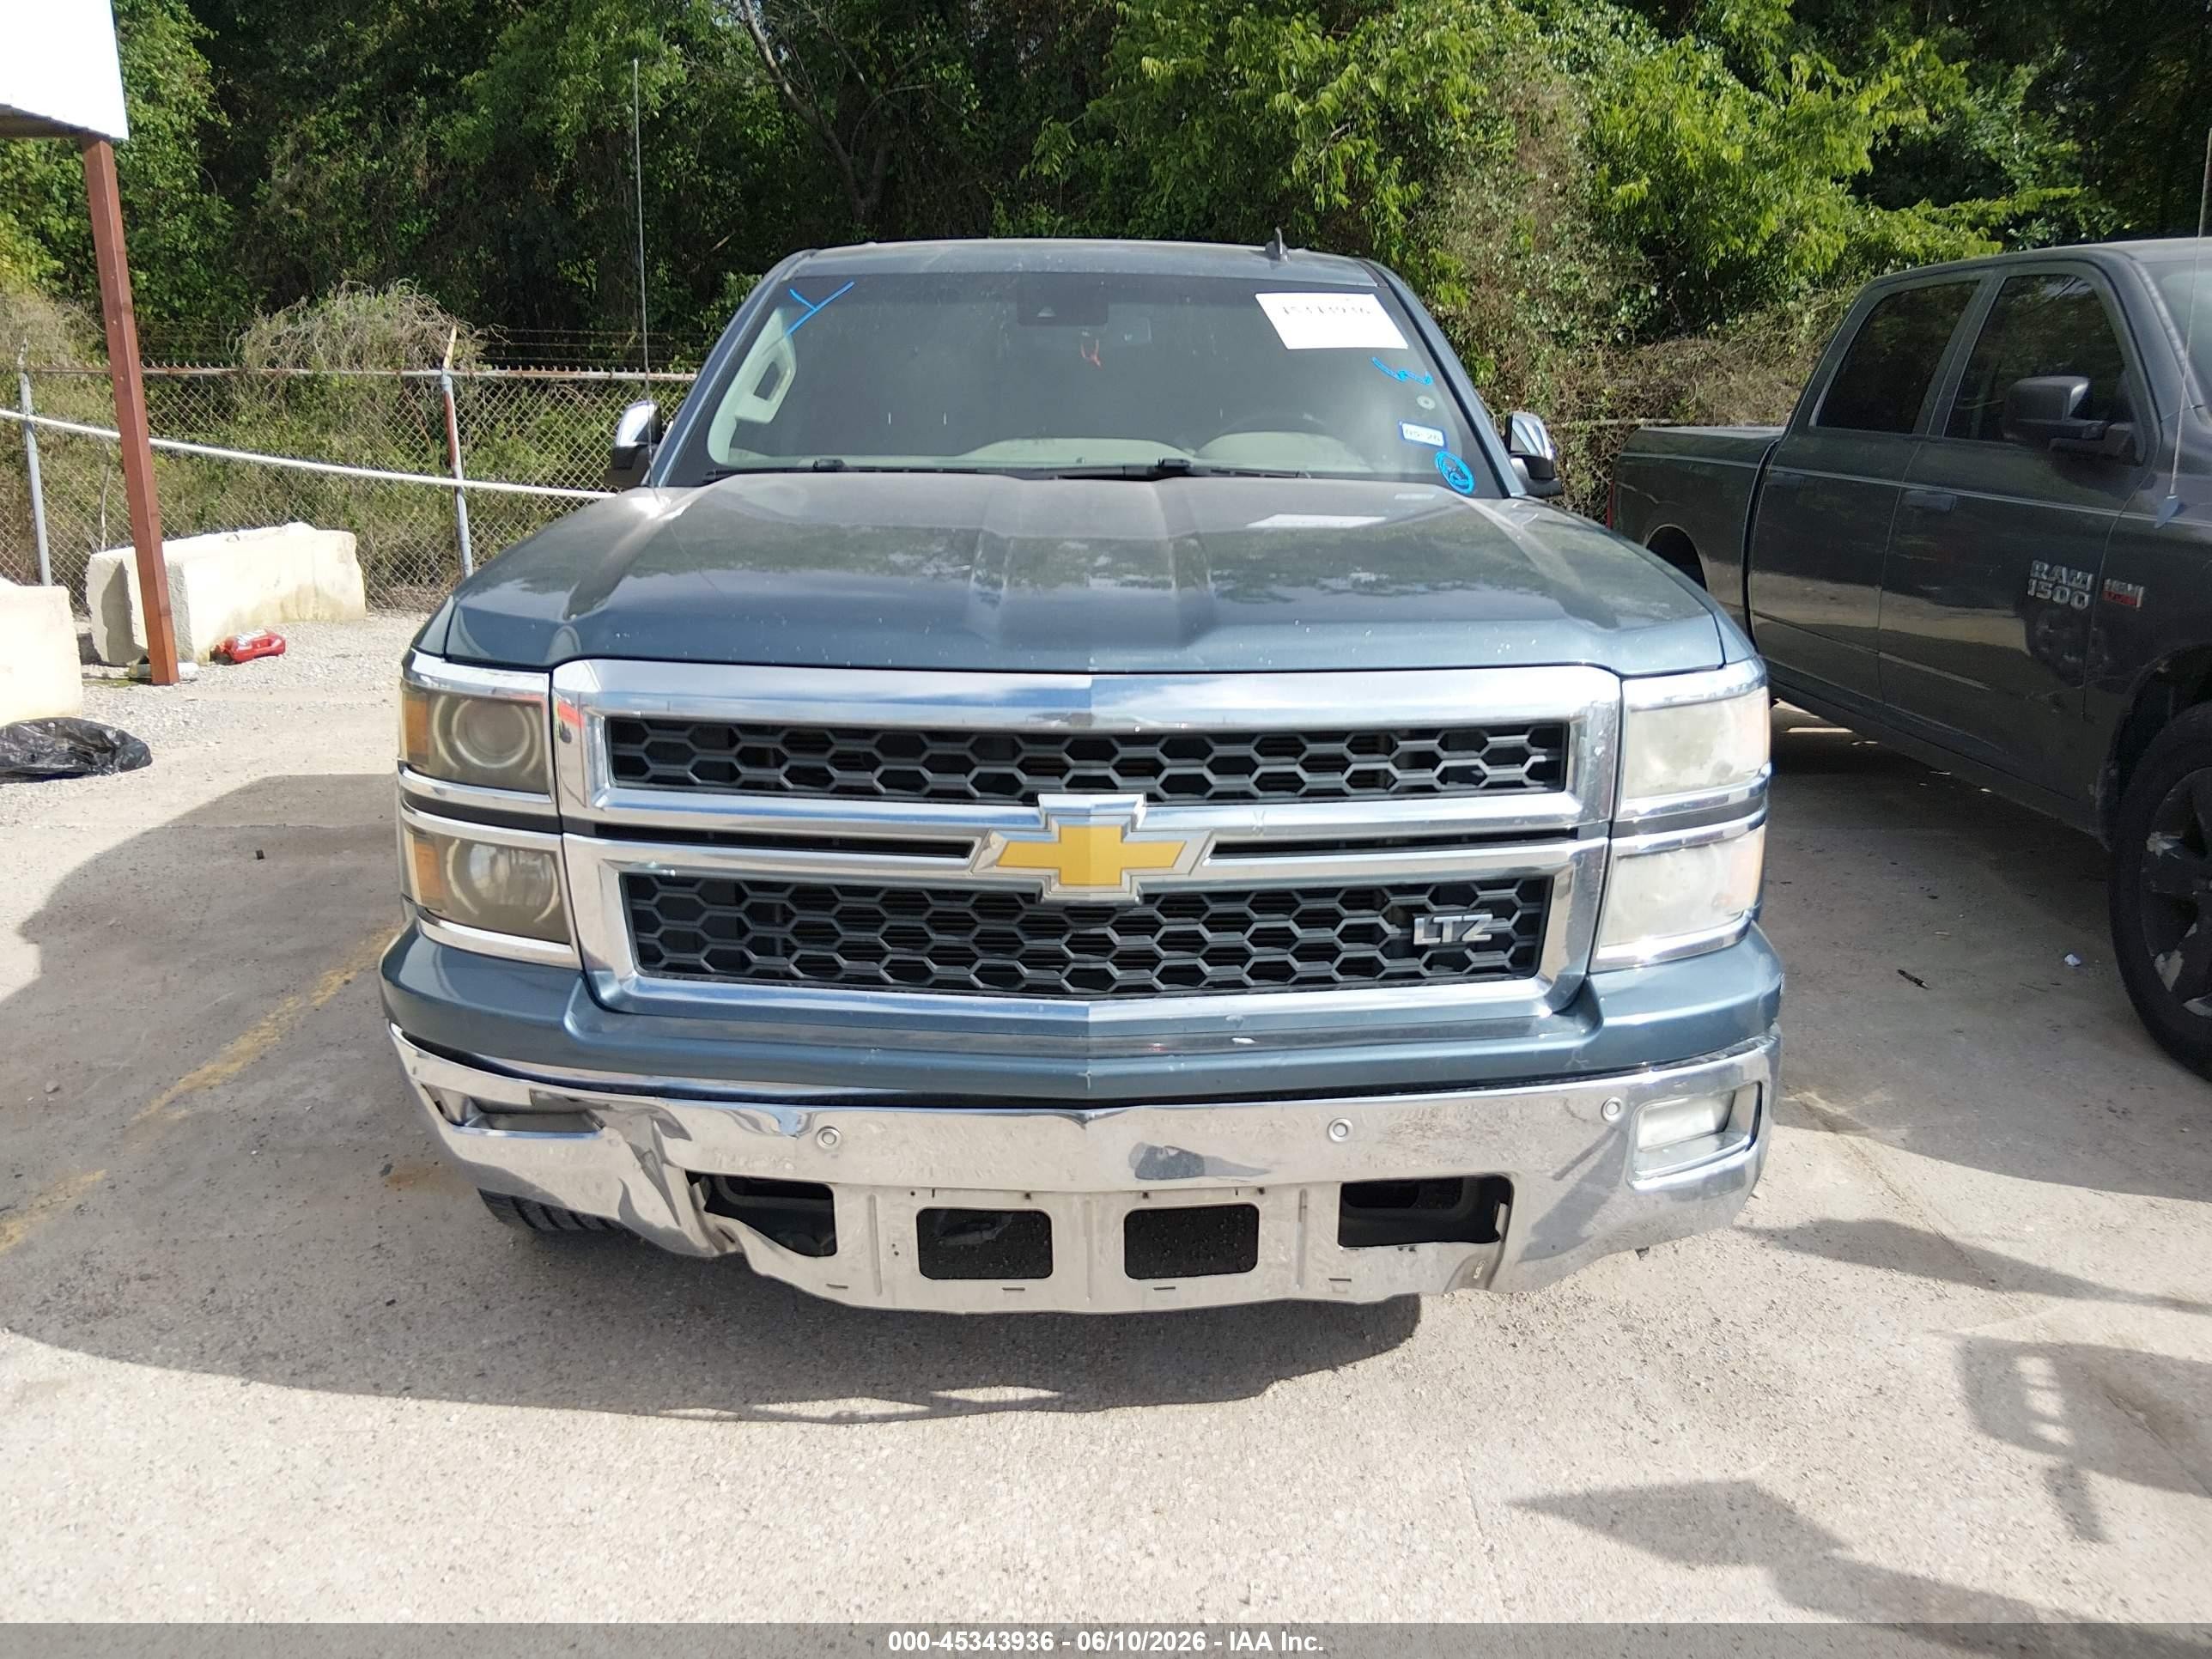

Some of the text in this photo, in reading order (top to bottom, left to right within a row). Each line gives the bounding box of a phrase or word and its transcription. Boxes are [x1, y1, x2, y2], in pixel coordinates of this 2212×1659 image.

[2030, 559, 2094, 592] RAM
[2027, 579, 2091, 611] 1500
[1413, 913, 1494, 946] LTZ
